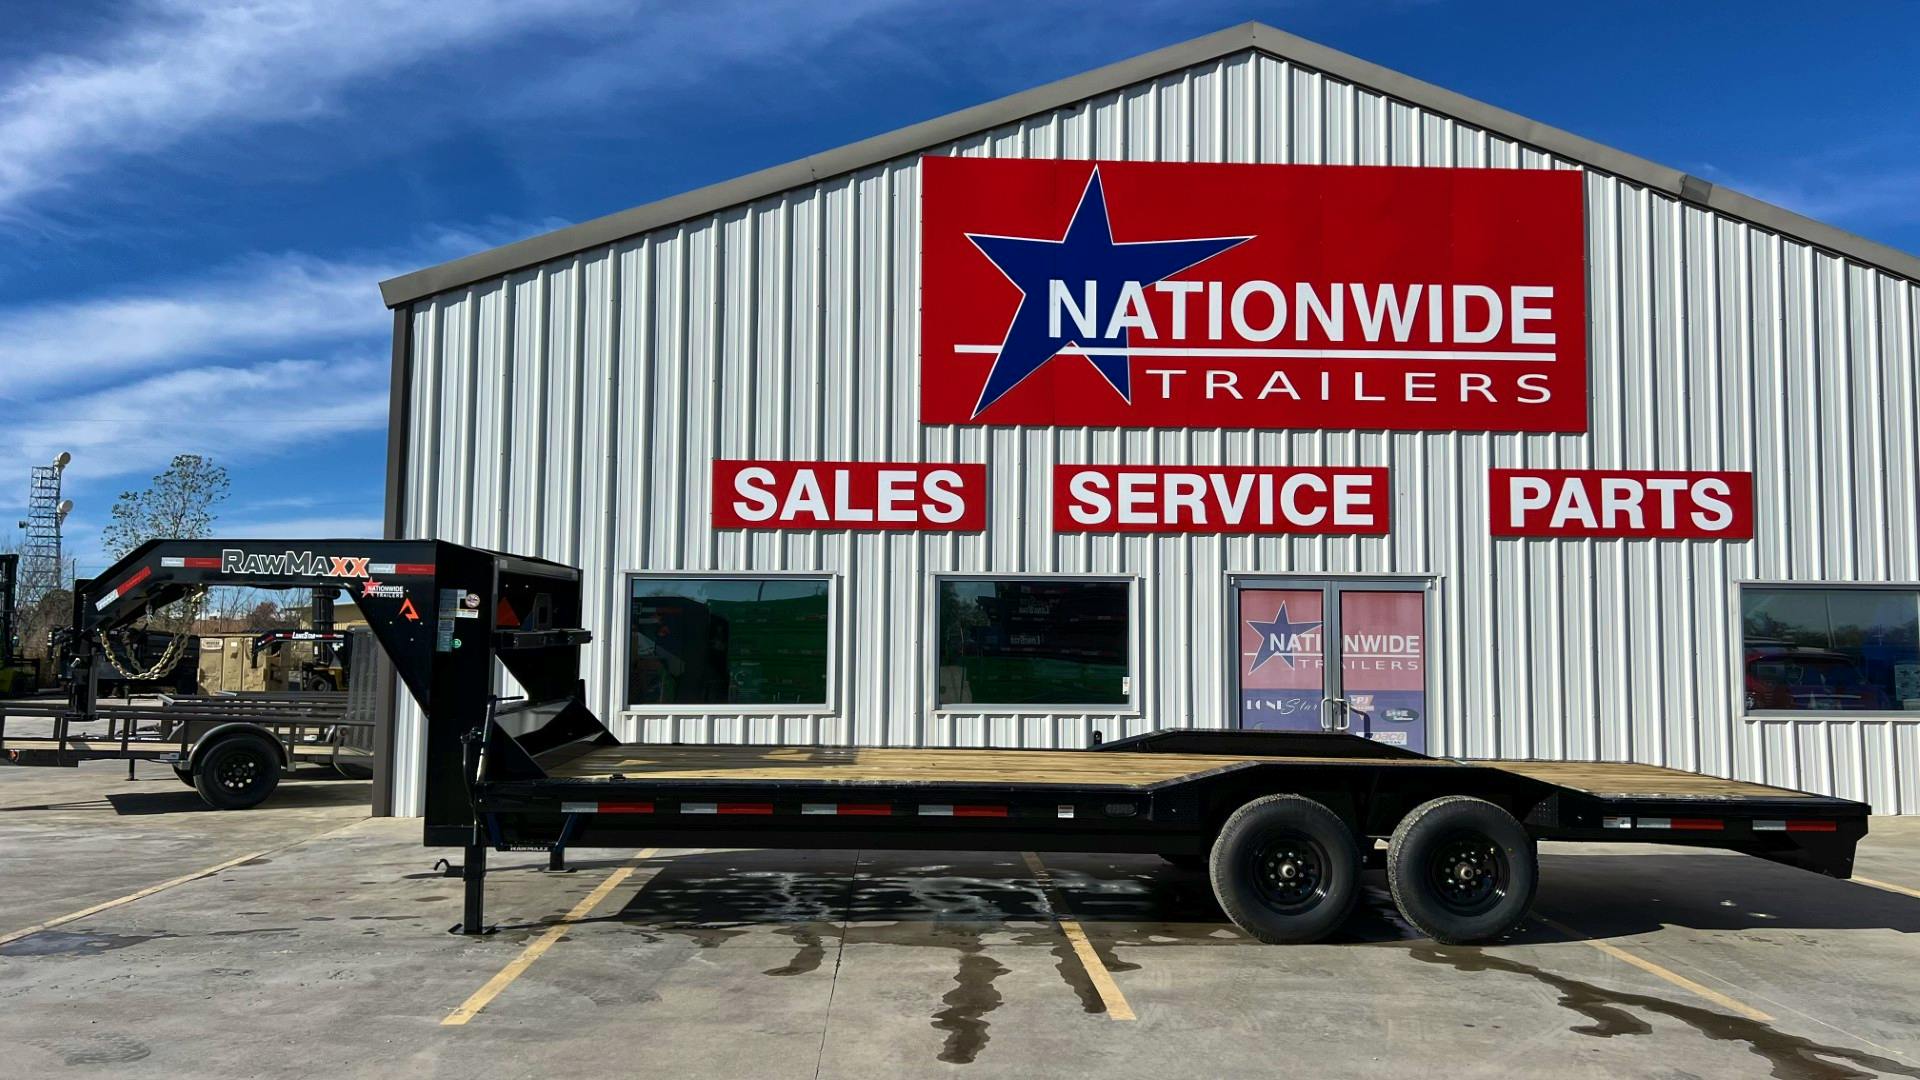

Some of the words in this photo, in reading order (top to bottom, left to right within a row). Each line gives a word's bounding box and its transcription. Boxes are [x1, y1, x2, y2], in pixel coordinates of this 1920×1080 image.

[1048, 279, 1557, 345] NATIONWIDE
[1145, 369, 1552, 404] TRAILERS
[732, 466, 965, 524] SALES
[1068, 471, 1374, 526] SERVICE
[1509, 476, 1733, 531] PARTS
[1269, 633, 1420, 653] NATINWIDE
[1299, 659, 1419, 670] TRILERS
